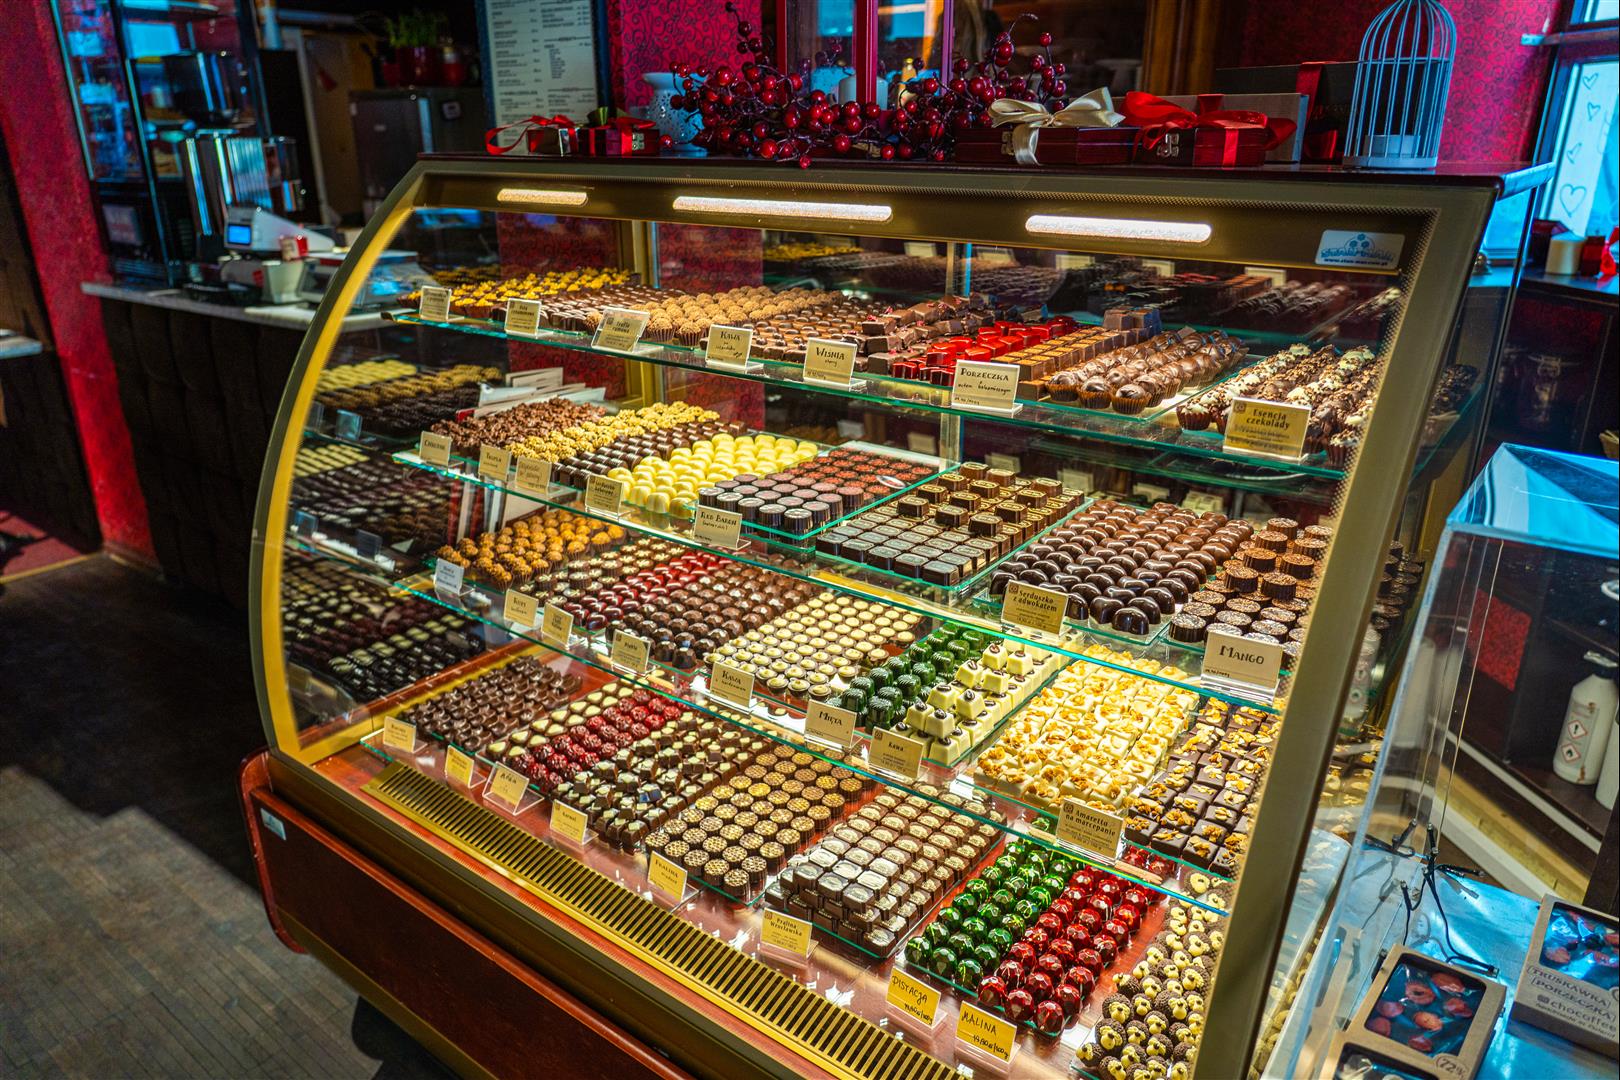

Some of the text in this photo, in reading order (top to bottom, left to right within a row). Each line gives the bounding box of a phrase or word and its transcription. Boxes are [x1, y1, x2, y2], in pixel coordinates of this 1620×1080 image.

[960, 367, 1009, 382] PORZECZKA
[1253, 408, 1287, 421] Esencja
[1246, 417, 1290, 430] czekolady
[1018, 597, 1057, 612] adwokatem
[1019, 590, 1054, 604] Serduszko
[1219, 644, 1265, 665] MANGO
[1076, 810, 1109, 827] Amaretto
[1075, 818, 1116, 837] marcepanie
[776, 917, 797, 929] Pralina
[891, 975, 928, 1005] PISTACJA
[1533, 967, 1607, 1007] TRUSKAWKA
[1536, 980, 1612, 1020] PORZECZKA
[961, 1010, 997, 1036] MALINA
